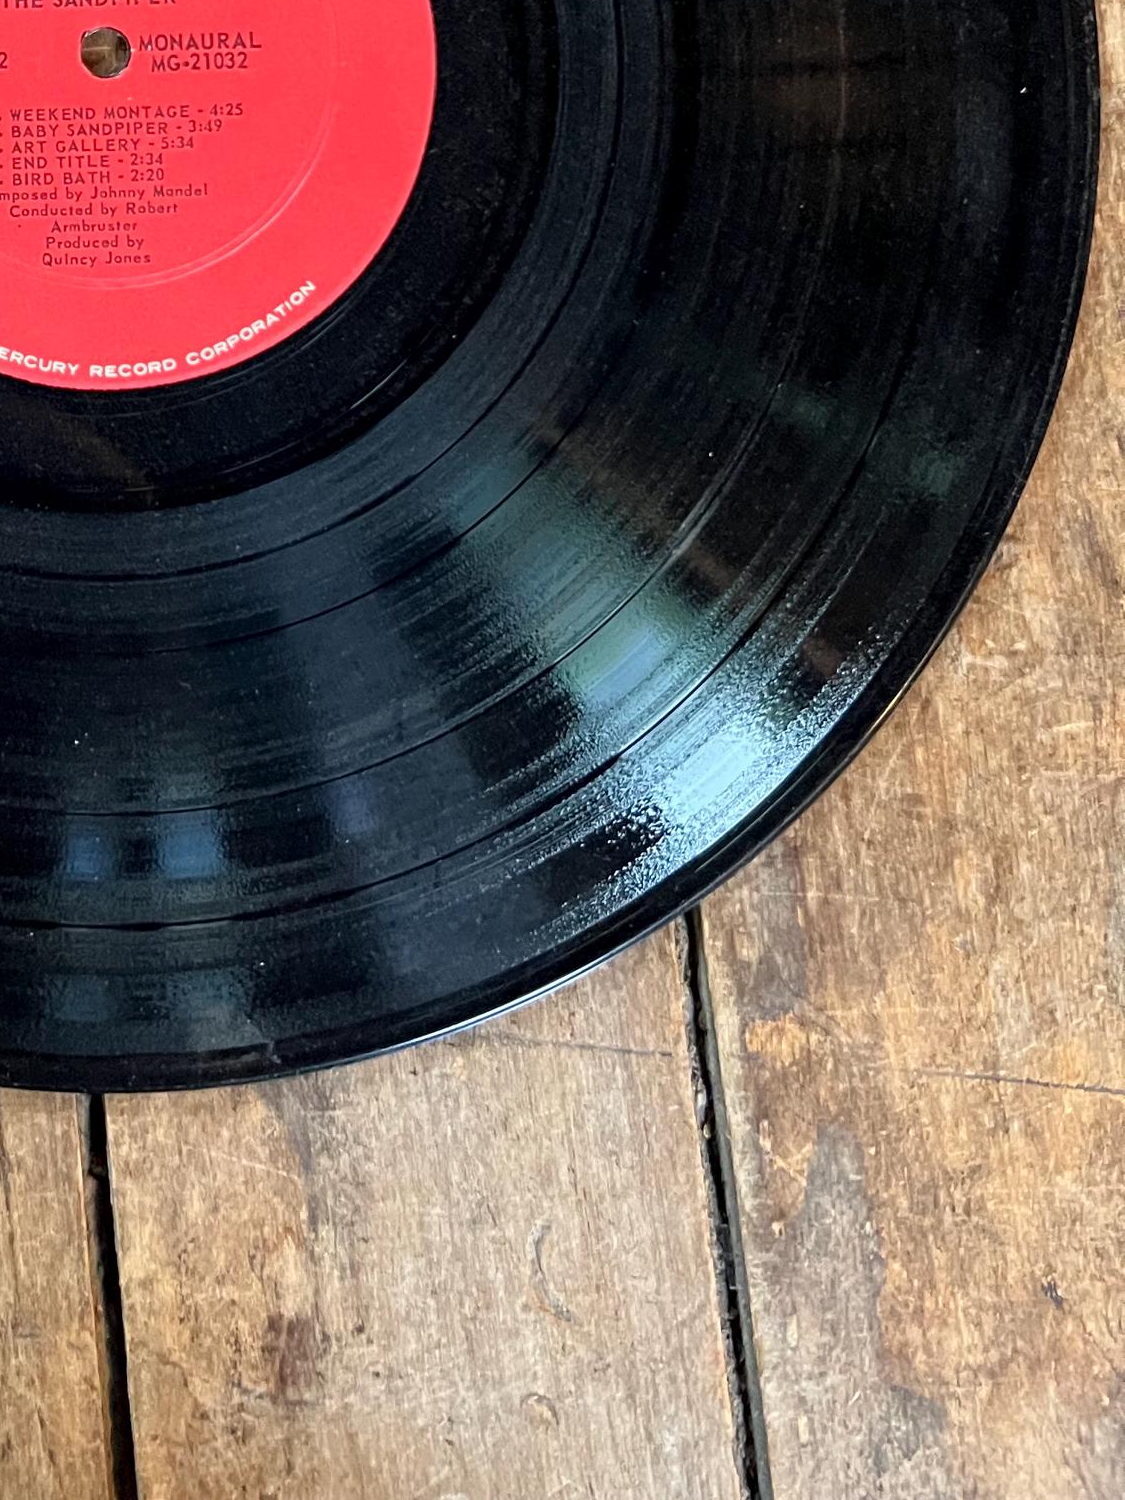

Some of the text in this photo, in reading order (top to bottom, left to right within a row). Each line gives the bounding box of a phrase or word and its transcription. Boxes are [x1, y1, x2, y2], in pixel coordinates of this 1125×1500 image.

[139, 32, 261, 50] MONAURAL
[9, 108, 97, 122] WEEKEND
[103, 105, 190, 120] MONTAGE
[209, 103, 244, 117] 4:25
[10, 124, 61, 139] BABY
[66, 122, 168, 136] SANDPIPER
[187, 120, 223, 133] 3:49
[10, 141, 47, 155] ART
[54, 139, 141, 152] GALLERY
[160, 137, 195, 150] 5:34
[11, 157, 48, 170] END
[55, 155, 110, 169] TITLE
[129, 153, 164, 167] 2:34
[11, 173, 55, 186] BIRD
[62, 172, 111, 185] BATH
[129, 169, 165, 183] 2:20
[65, 187, 83, 201] by
[89, 186, 146, 201] Johnny
[152, 184, 209, 198] Mandel
[9, 203, 178, 218] Conducted by Robert
[50, 220, 138, 234] Armbruster
[45, 237, 145, 250] Produced by
[41, 252, 152, 268] Quincy Jones
[89, 357, 177, 378] RECORD
[185, 280, 316, 366] CORPORATION
